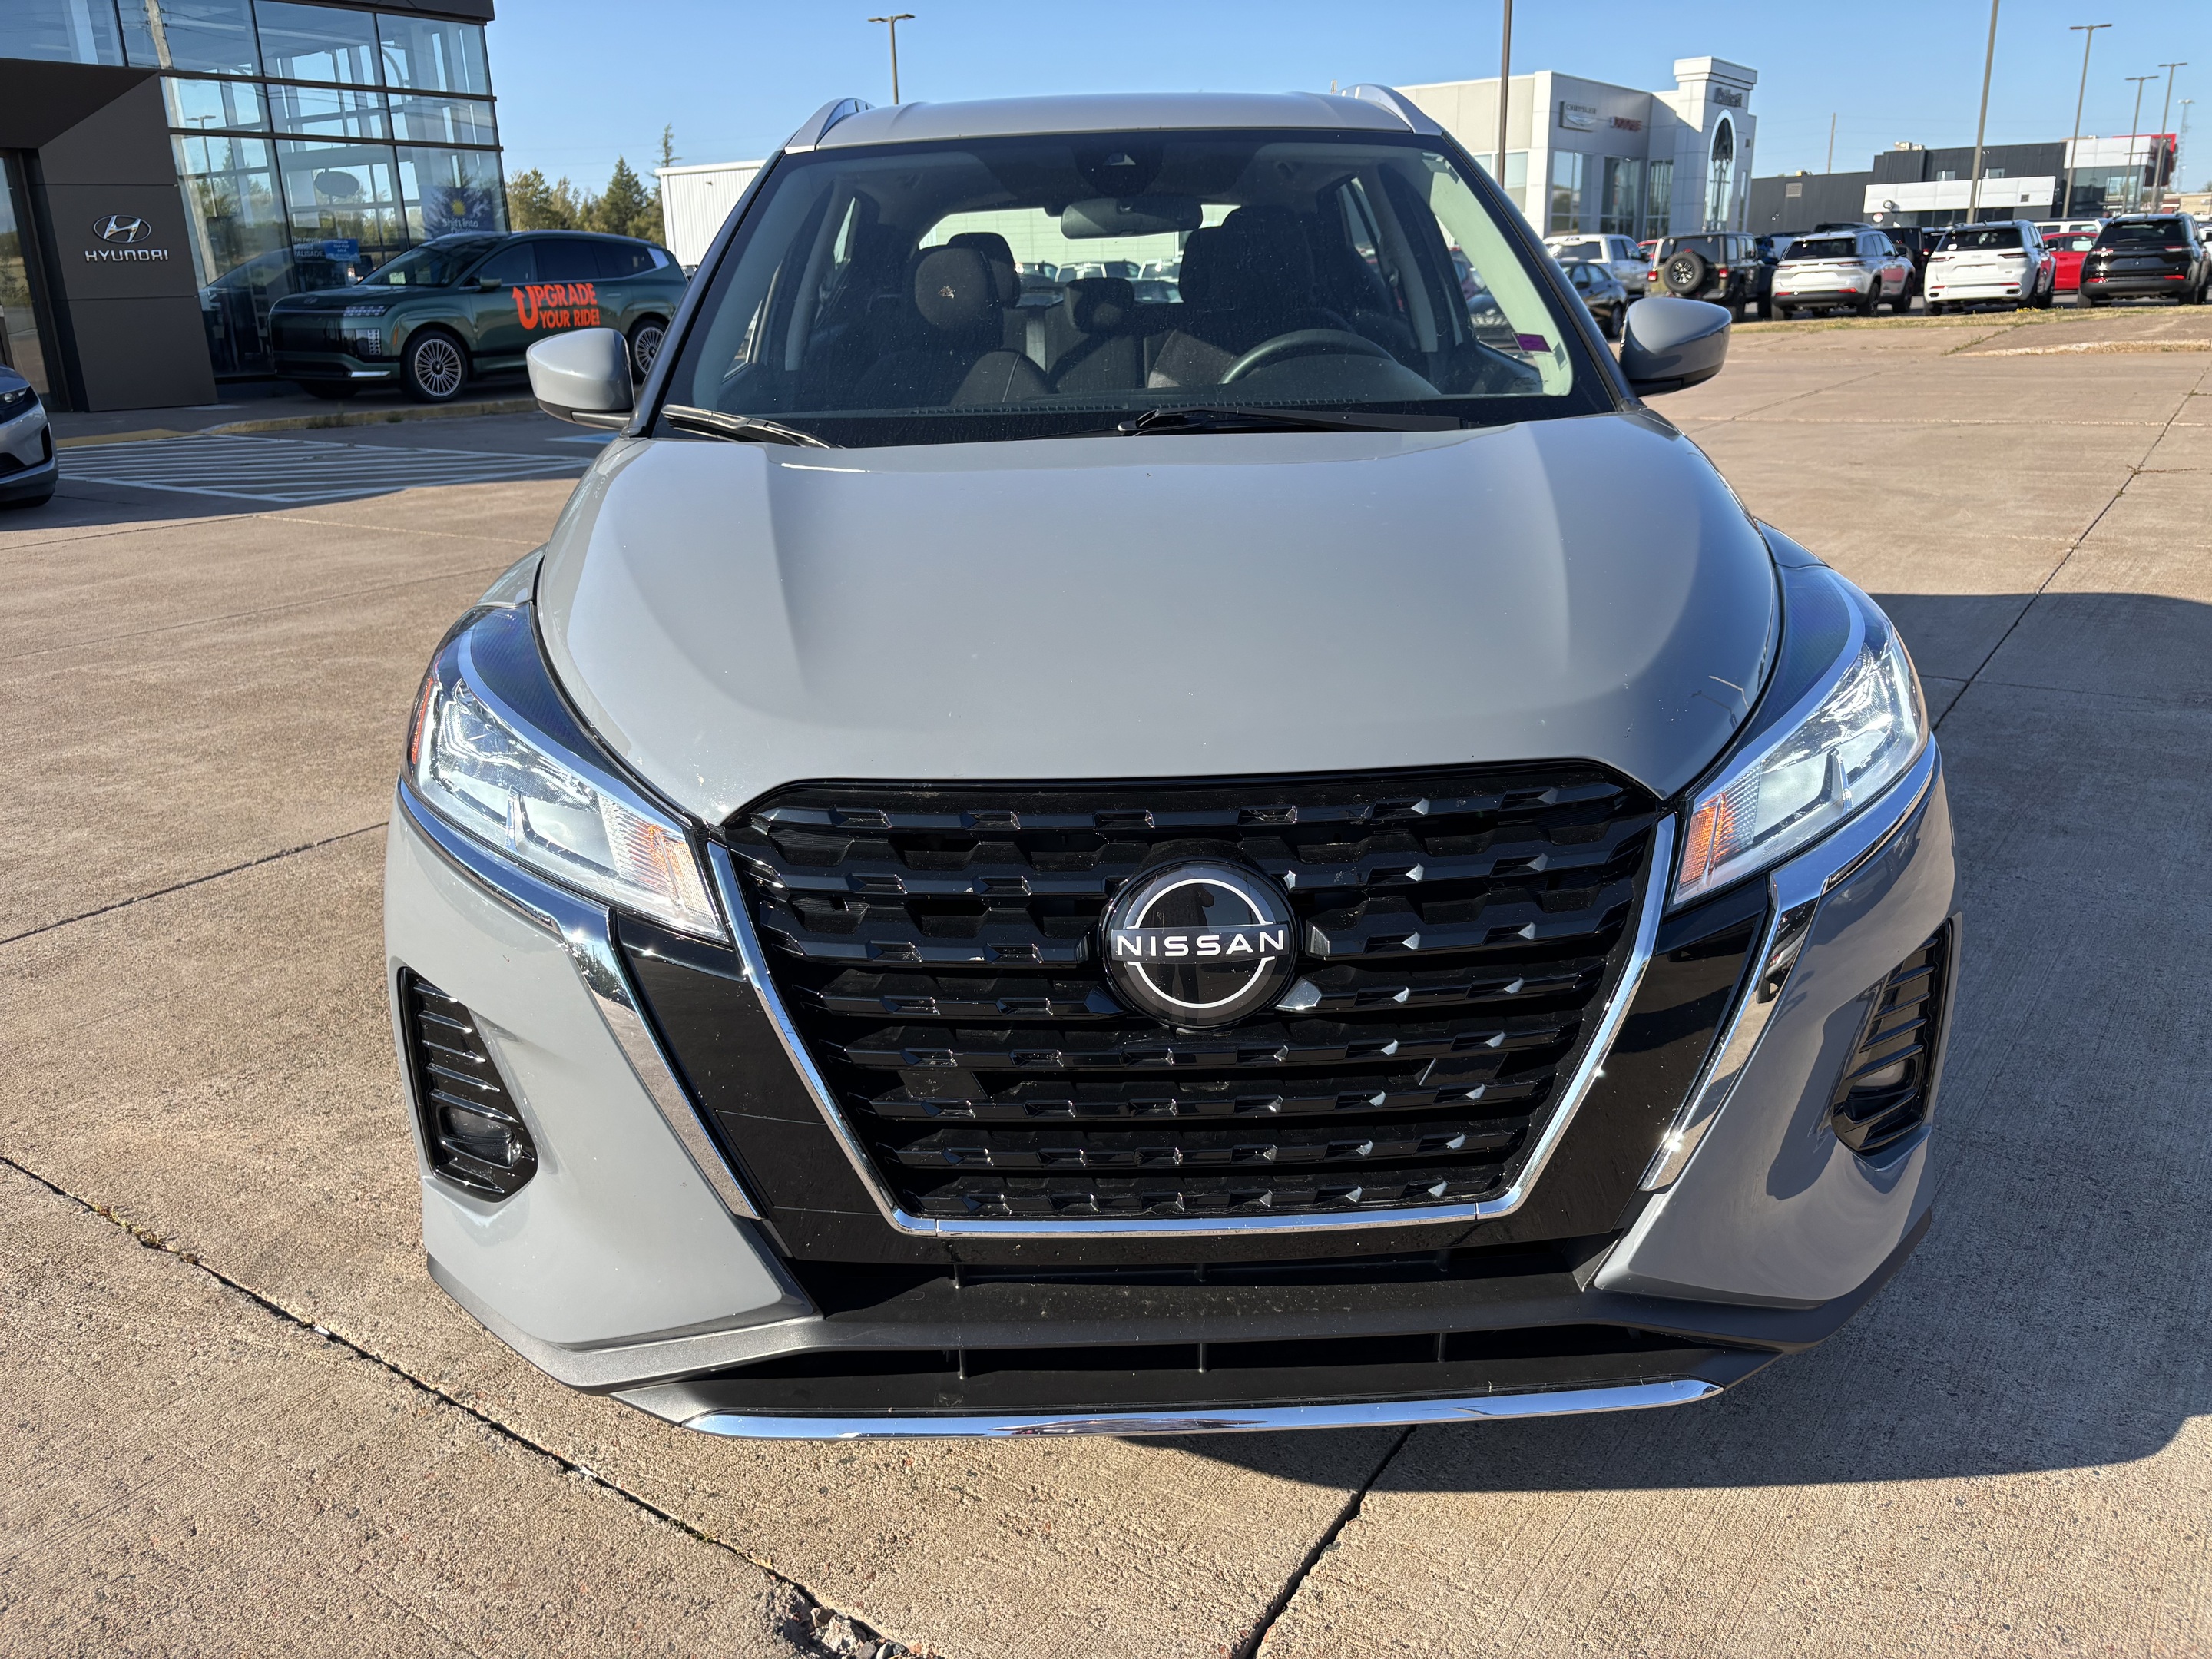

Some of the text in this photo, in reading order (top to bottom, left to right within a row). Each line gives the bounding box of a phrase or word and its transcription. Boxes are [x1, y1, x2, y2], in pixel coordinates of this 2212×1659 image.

[84, 249, 169, 262] HYUNDAI
[512, 283, 598, 330] UPGRADE
[539, 308, 601, 329] YOUR RIDE!
[1116, 929, 1284, 957] NISSAN
